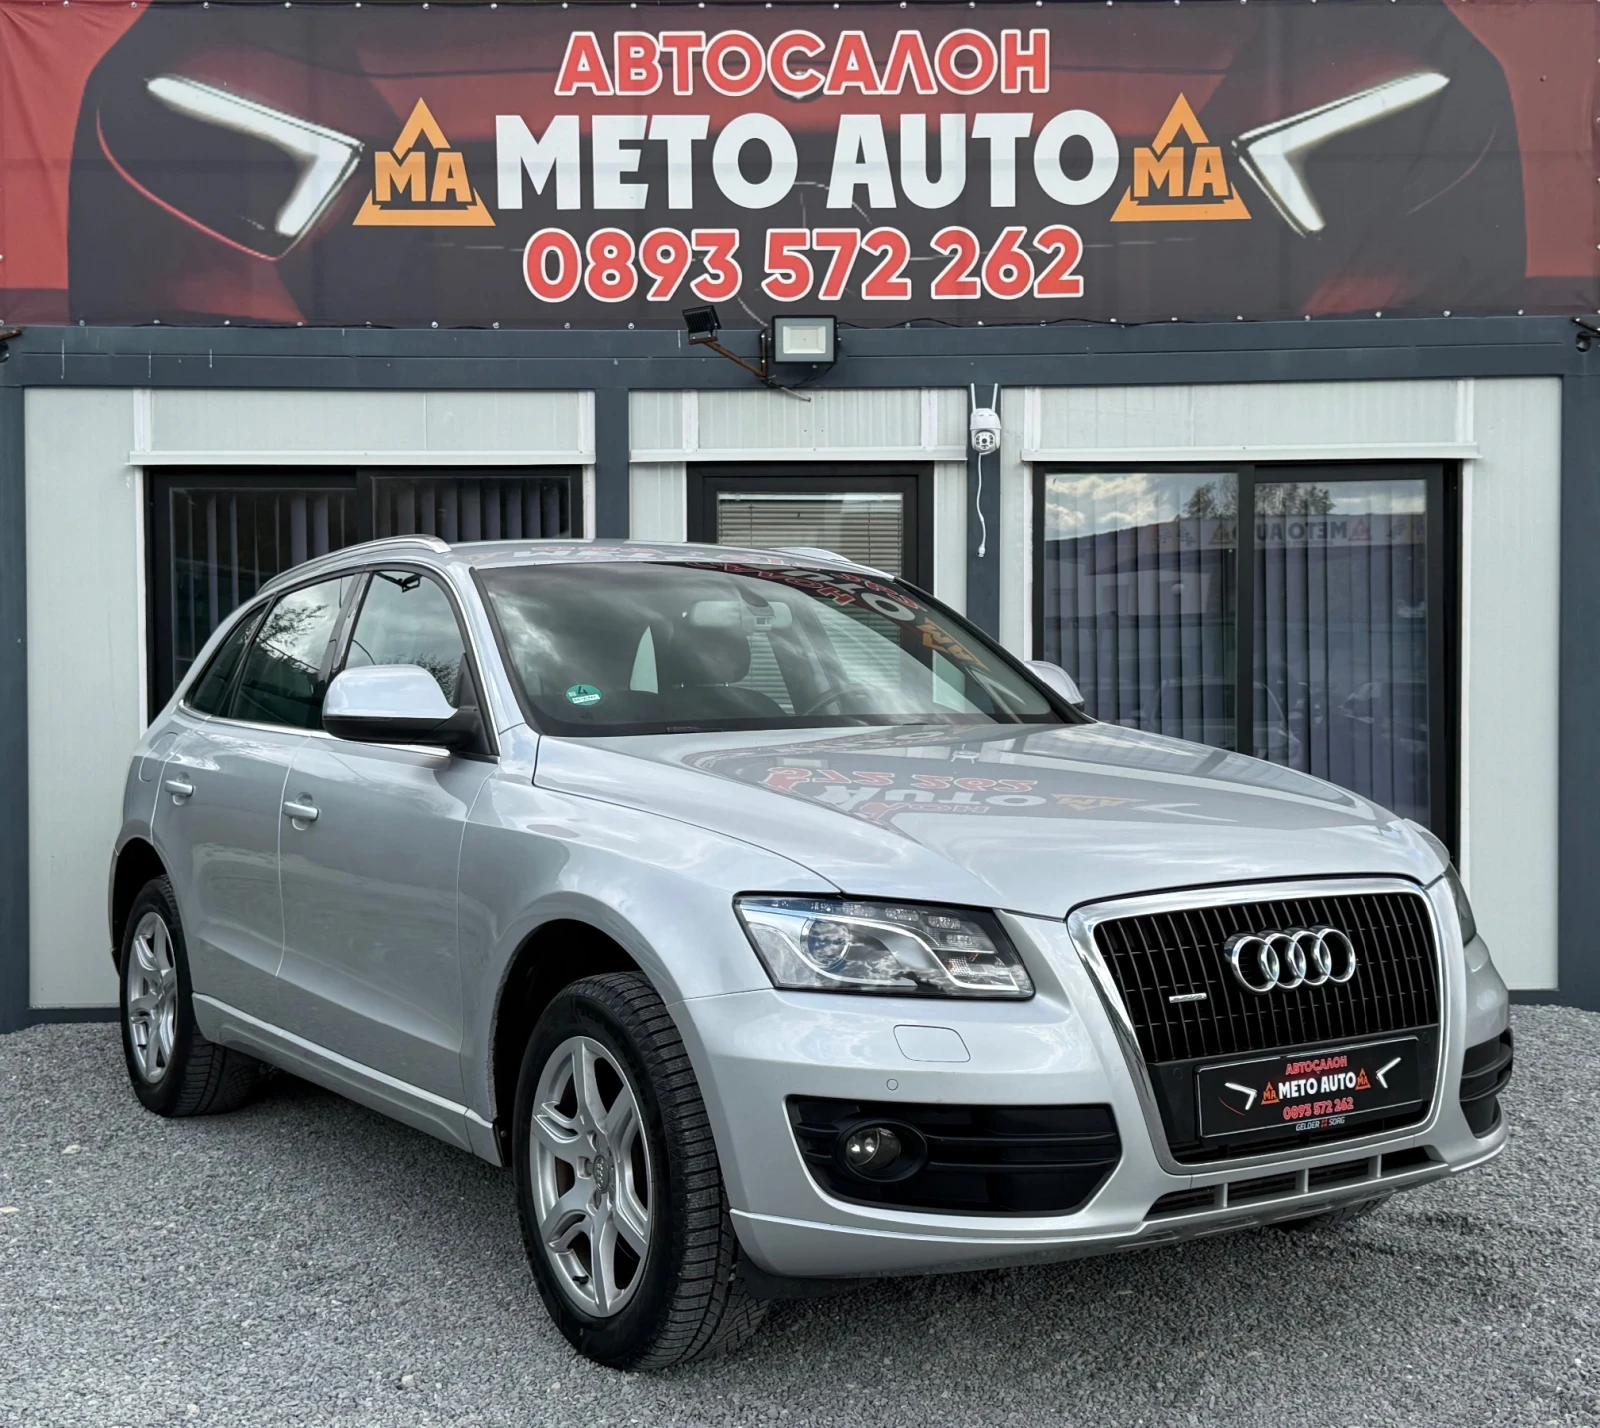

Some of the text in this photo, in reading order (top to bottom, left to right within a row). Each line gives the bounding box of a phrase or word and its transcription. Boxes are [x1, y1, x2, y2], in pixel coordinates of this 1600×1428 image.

[554, 29, 1050, 97] АВТОСАЛОН
[374, 151, 474, 202] MA
[495, 109, 1120, 210] METO AUTO
[1133, 146, 1229, 197] MA
[523, 224, 1084, 303] 0893 572 262
[577, 685, 589, 695] 4
[1285, 1055, 1347, 1075] АВТОСАЛОН
[1278, 1071, 1356, 1099] METO AUTO
[1283, 1096, 1354, 1120] 0893 572 262
[1295, 1116, 1346, 1131] GELDER SORG
